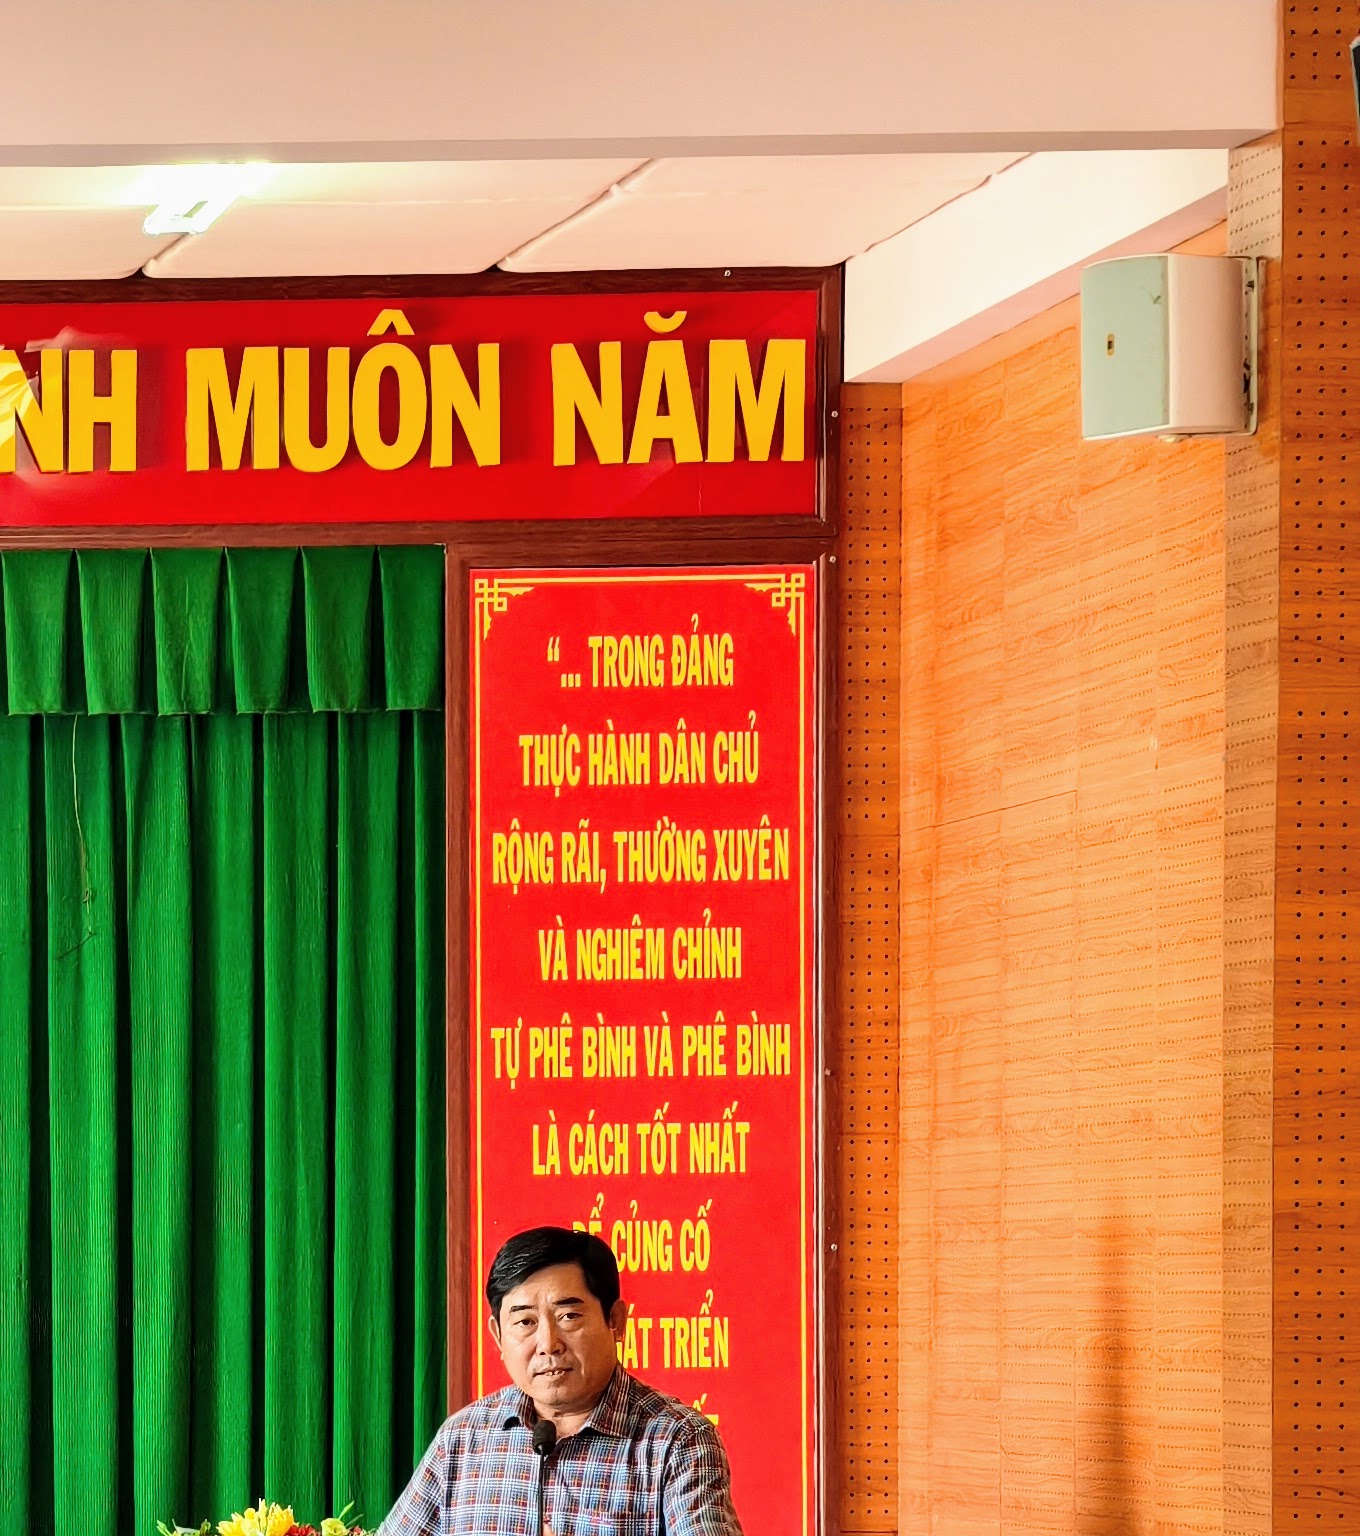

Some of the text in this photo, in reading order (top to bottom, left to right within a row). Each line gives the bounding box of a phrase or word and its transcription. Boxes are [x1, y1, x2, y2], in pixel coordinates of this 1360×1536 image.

[186, 309, 501, 473] MUÔN
[551, 310, 807, 466] NĂM
[588, 635, 665, 688] TRONG
[671, 613, 734, 687] ĐẢNG
[519, 710, 760, 797] THỰC HÀNH DÂN CHỦ
[492, 814, 790, 895] RỘNG RÃI, THƯỜNG XUYÊN
[538, 908, 742, 982] VÀ NGHIÊM CHỈNH
[491, 1010, 791, 1089] TỰ PHÊ BÌNH VÀ PHÊ BÌNH
[532, 1101, 751, 1176] LÀ CÁCH TỐT NHẤT
[611, 1199, 673, 1273] CỦNG
[680, 1198, 712, 1272] CỐ
[660, 1288, 729, 1369] TRIỂN
